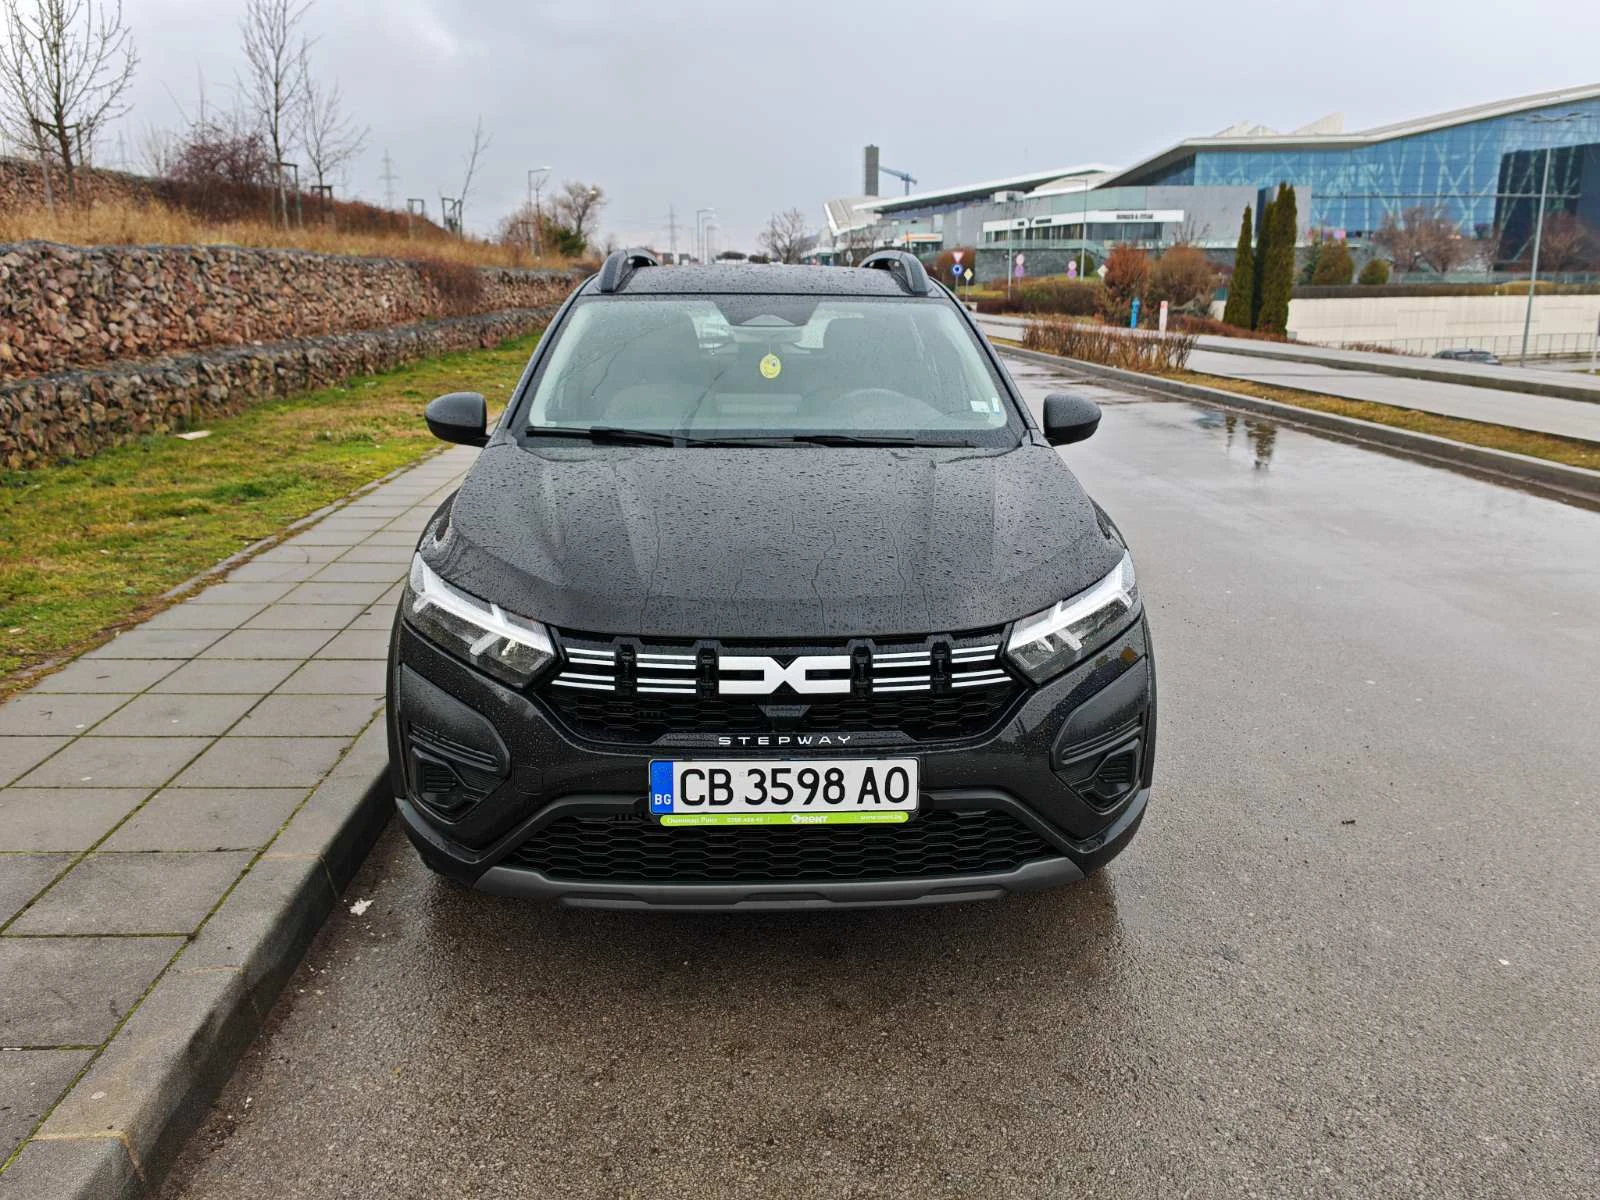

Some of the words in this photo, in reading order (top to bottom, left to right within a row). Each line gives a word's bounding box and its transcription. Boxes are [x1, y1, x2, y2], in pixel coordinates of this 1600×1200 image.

[718, 735, 851, 746] STEPWAY
[680, 768, 734, 806] CB
[744, 766, 846, 806] 3598
[856, 766, 910, 804] AO
[654, 793, 672, 806] BG
